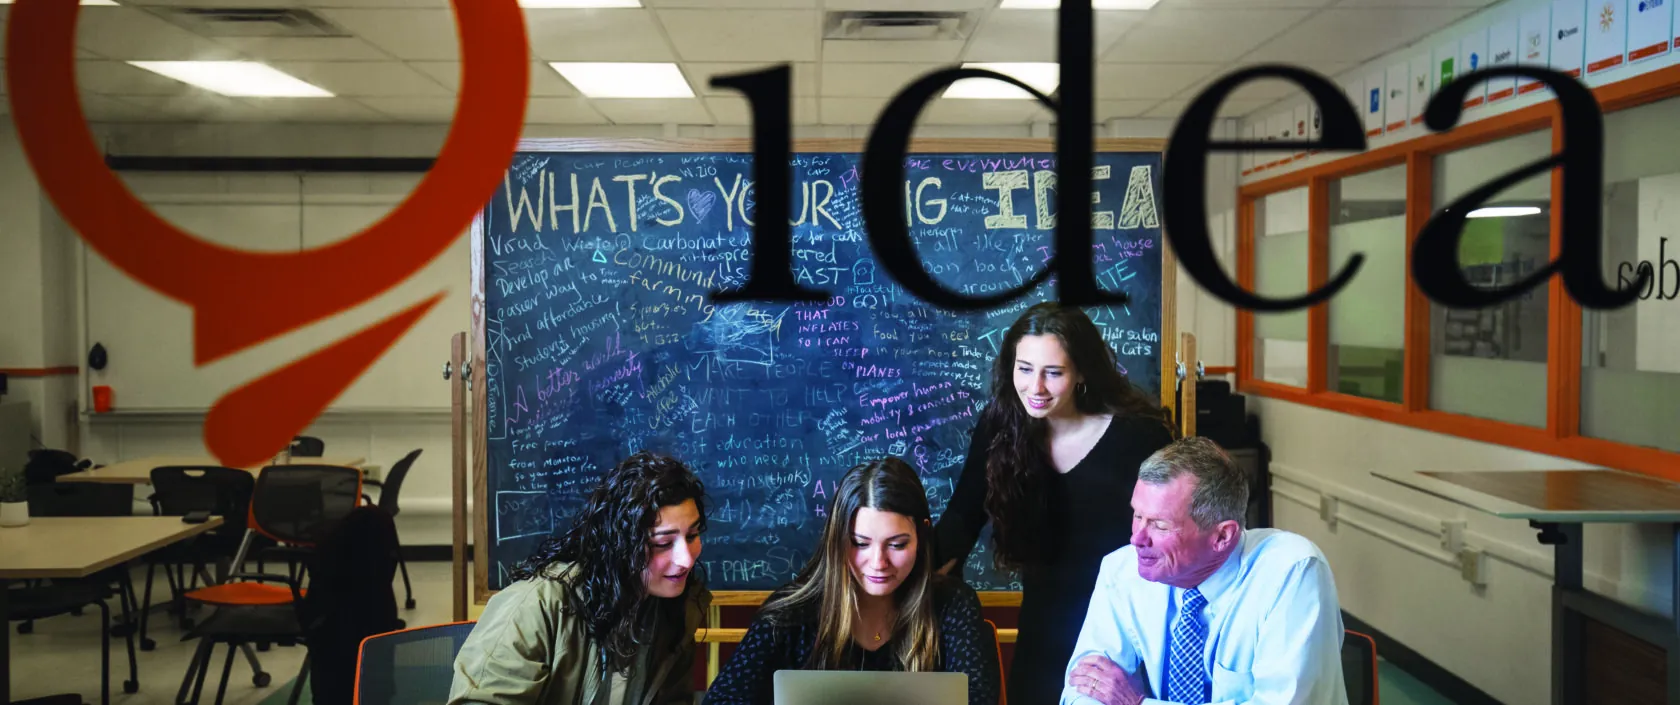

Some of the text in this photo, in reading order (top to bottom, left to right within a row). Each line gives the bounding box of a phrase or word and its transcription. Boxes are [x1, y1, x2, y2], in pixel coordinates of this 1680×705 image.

[504, 168, 684, 234] WHAT'S
[982, 164, 1160, 230] IDEA
[709, 0, 1641, 312] idea
